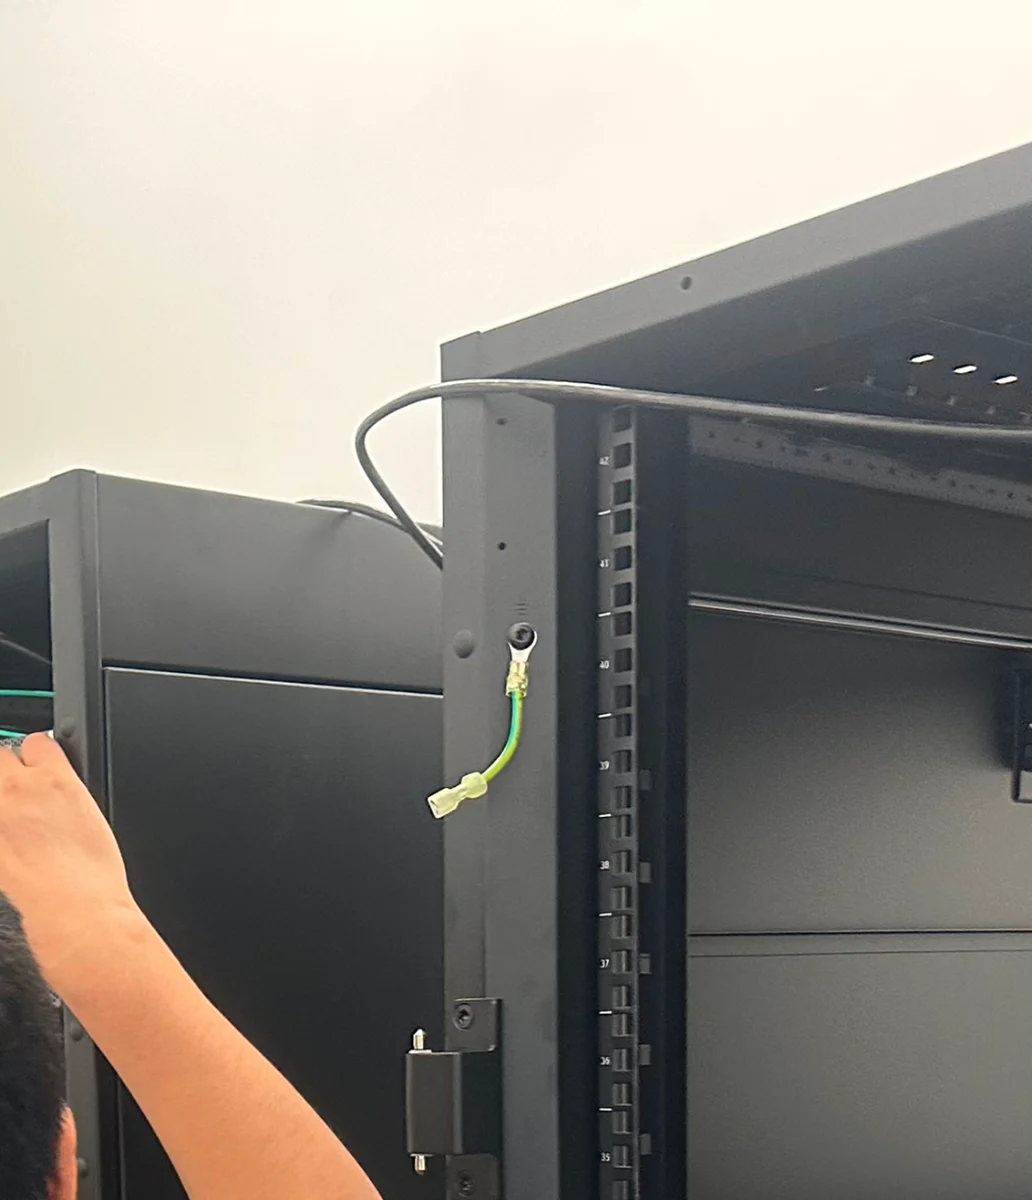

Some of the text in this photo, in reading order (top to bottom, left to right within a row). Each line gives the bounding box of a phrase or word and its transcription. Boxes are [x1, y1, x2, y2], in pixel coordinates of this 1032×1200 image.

[599, 659, 610, 670] 40
[599, 760, 610, 770] 39
[599, 859, 610, 870] 38
[600, 958, 610, 969] 37
[600, 1056, 611, 1066] 36
[600, 1152, 611, 1162] 35
